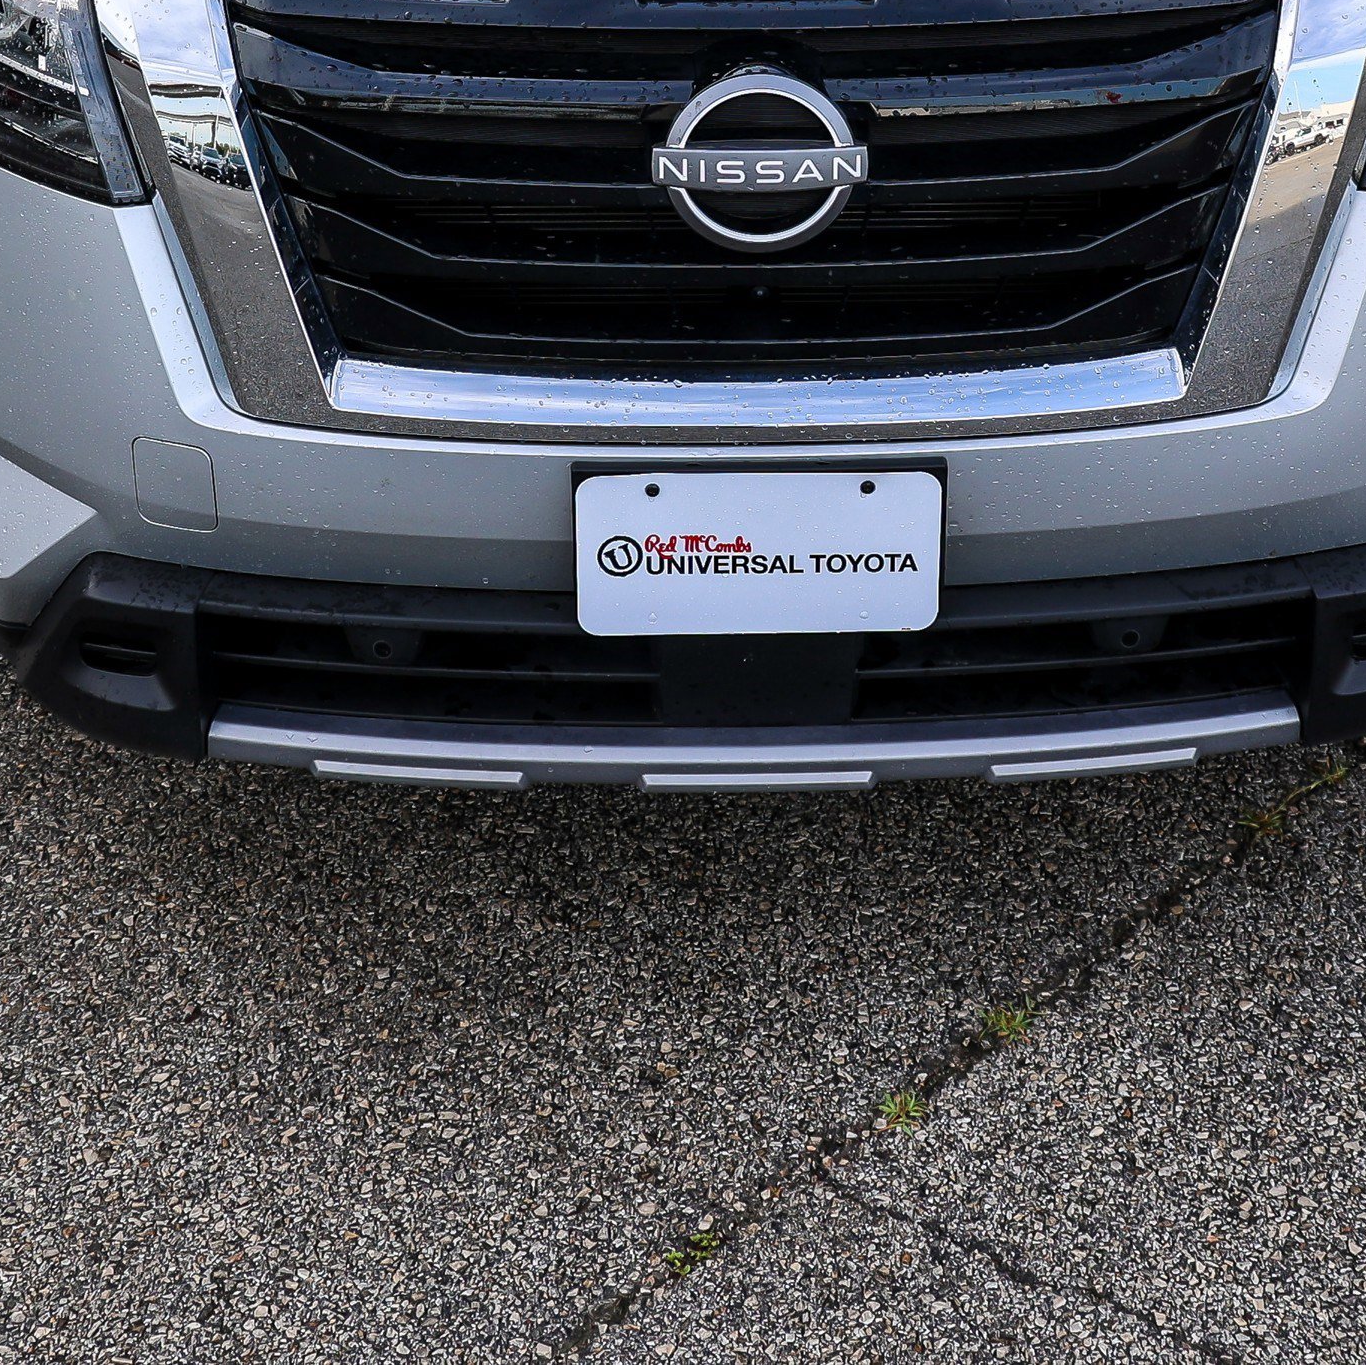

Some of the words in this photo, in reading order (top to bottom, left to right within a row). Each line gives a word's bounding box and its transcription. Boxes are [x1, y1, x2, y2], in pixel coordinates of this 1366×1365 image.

[658, 154, 862, 184] NISSAN
[644, 534, 677, 559] Red
[679, 535, 752, 553] McCombs
[646, 554, 804, 575] UNIVERSAL
[809, 553, 918, 573] TOYOTA
